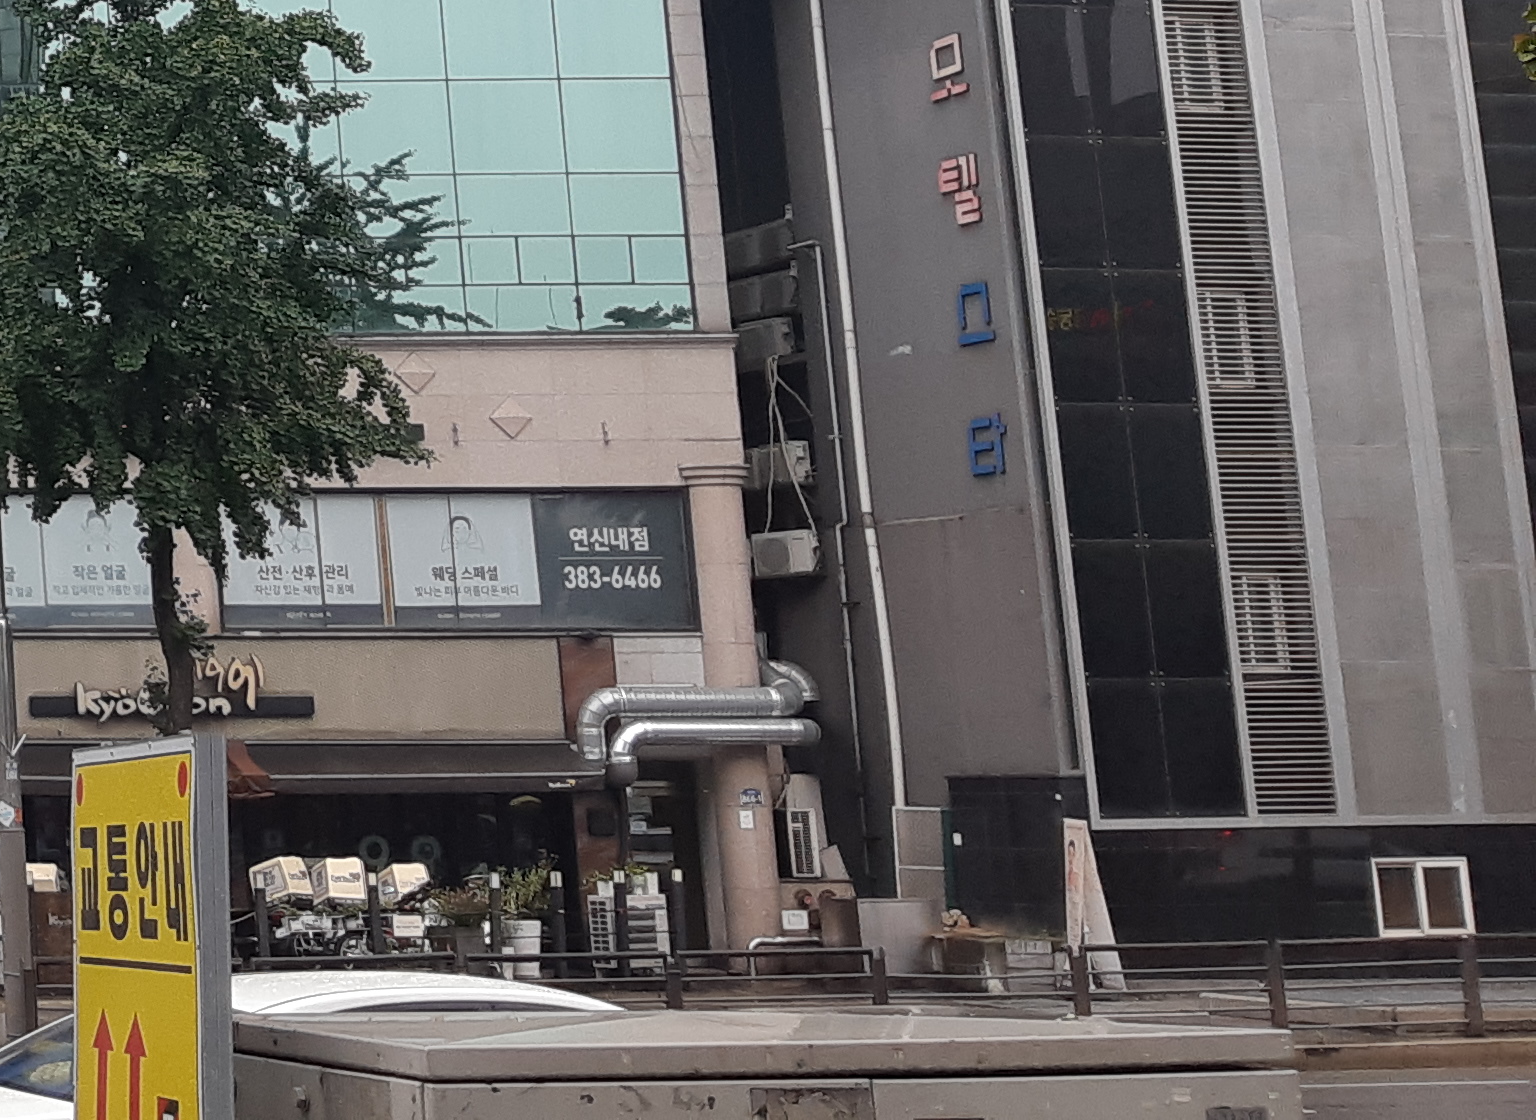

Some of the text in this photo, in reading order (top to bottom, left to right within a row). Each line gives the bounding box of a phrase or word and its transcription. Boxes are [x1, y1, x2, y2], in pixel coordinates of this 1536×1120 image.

[568, 526, 650, 552] 연신내점
[72, 564, 127, 581] 작은 얼굴
[323, 564, 349, 580] 관리
[460, 566, 500, 581] 스페셜
[562, 565, 663, 590] 383-6466
[79, 820, 190, 943] 교통안내
